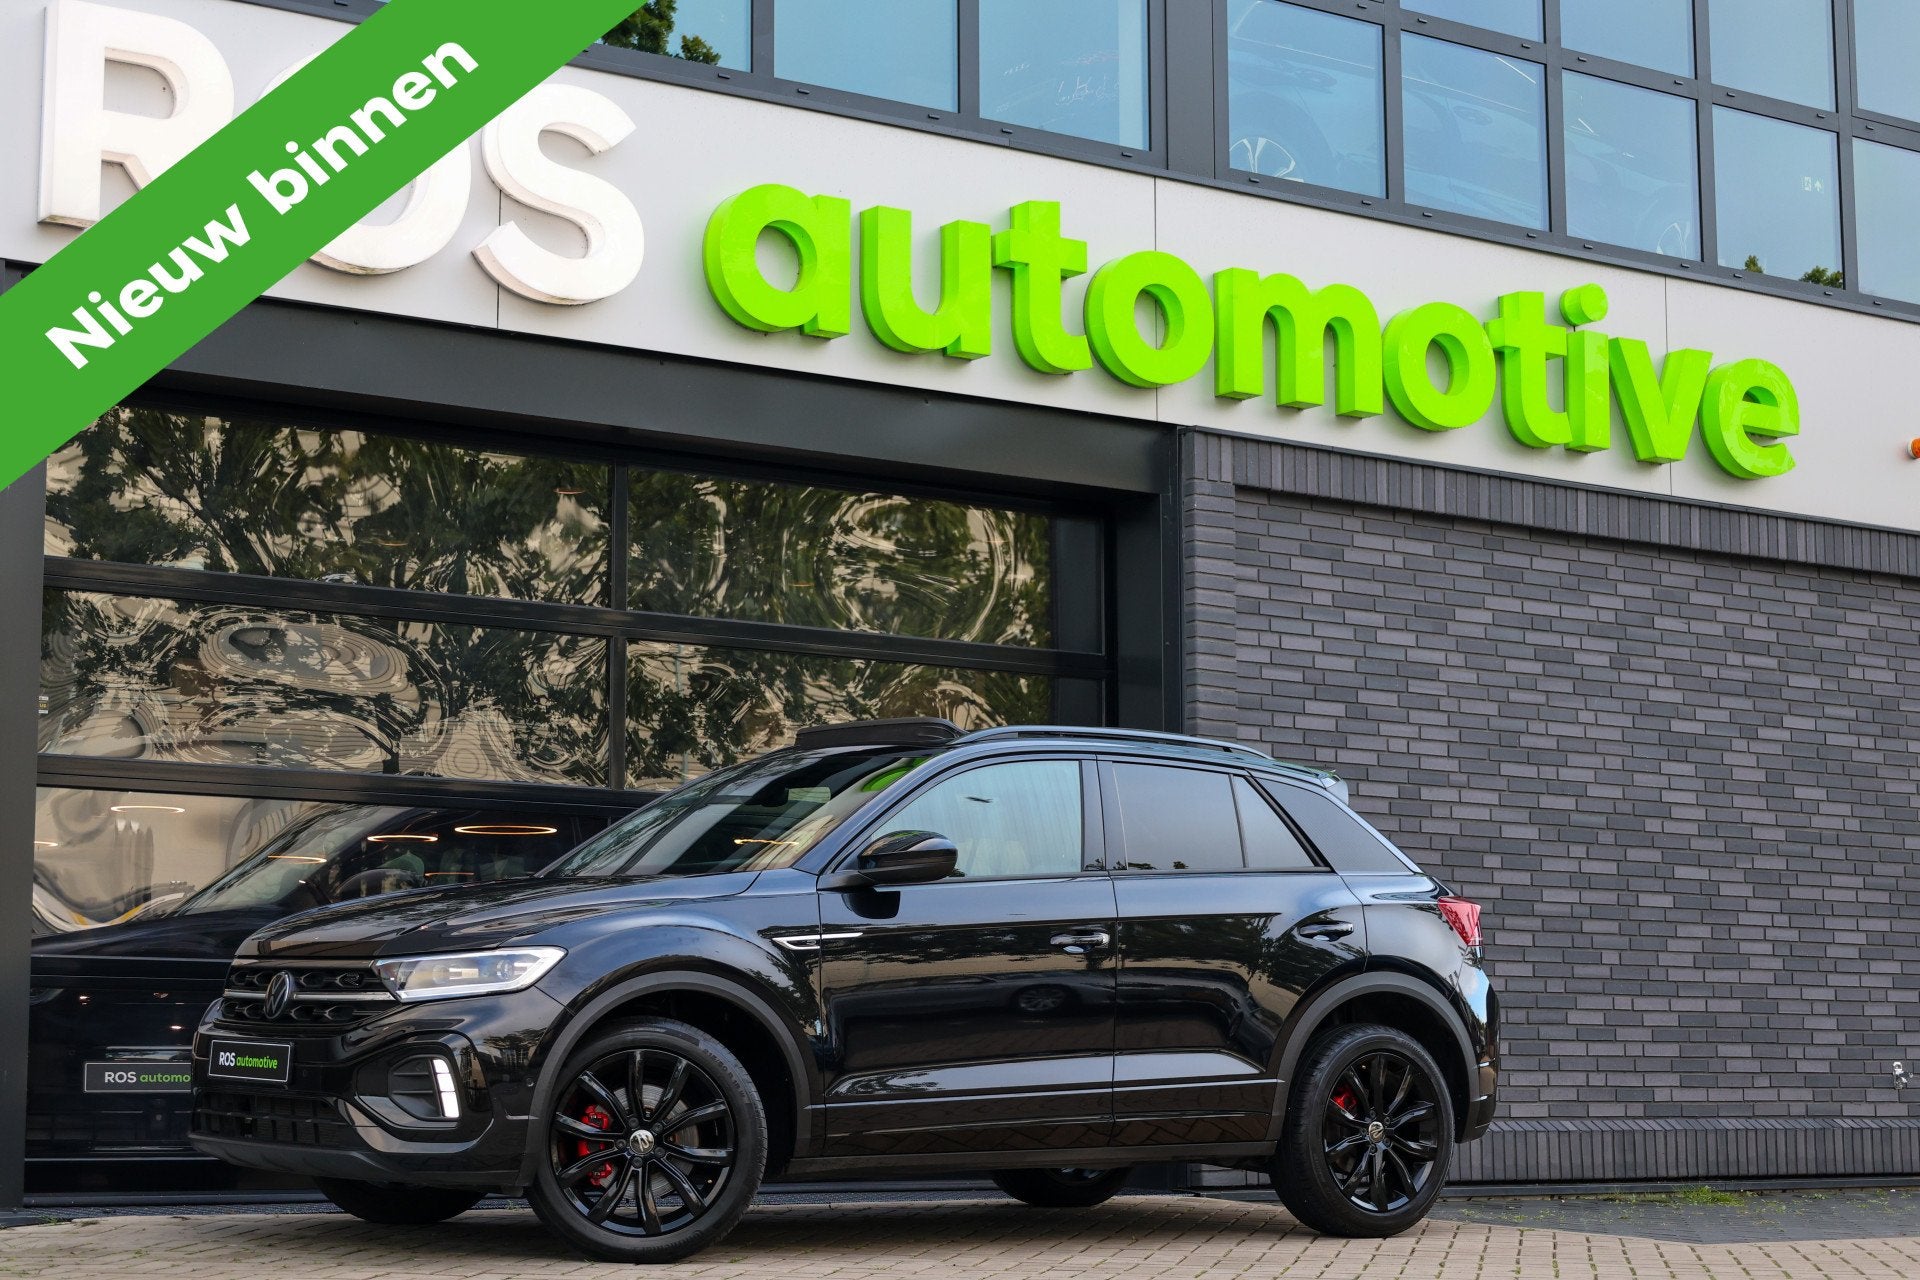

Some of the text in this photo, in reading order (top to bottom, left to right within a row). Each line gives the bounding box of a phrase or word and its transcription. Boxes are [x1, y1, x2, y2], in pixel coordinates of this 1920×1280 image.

[703, 184, 1799, 480] automotive
[218, 1051, 278, 1069] ROS automotive
[104, 1071, 191, 1083] ROS automo
